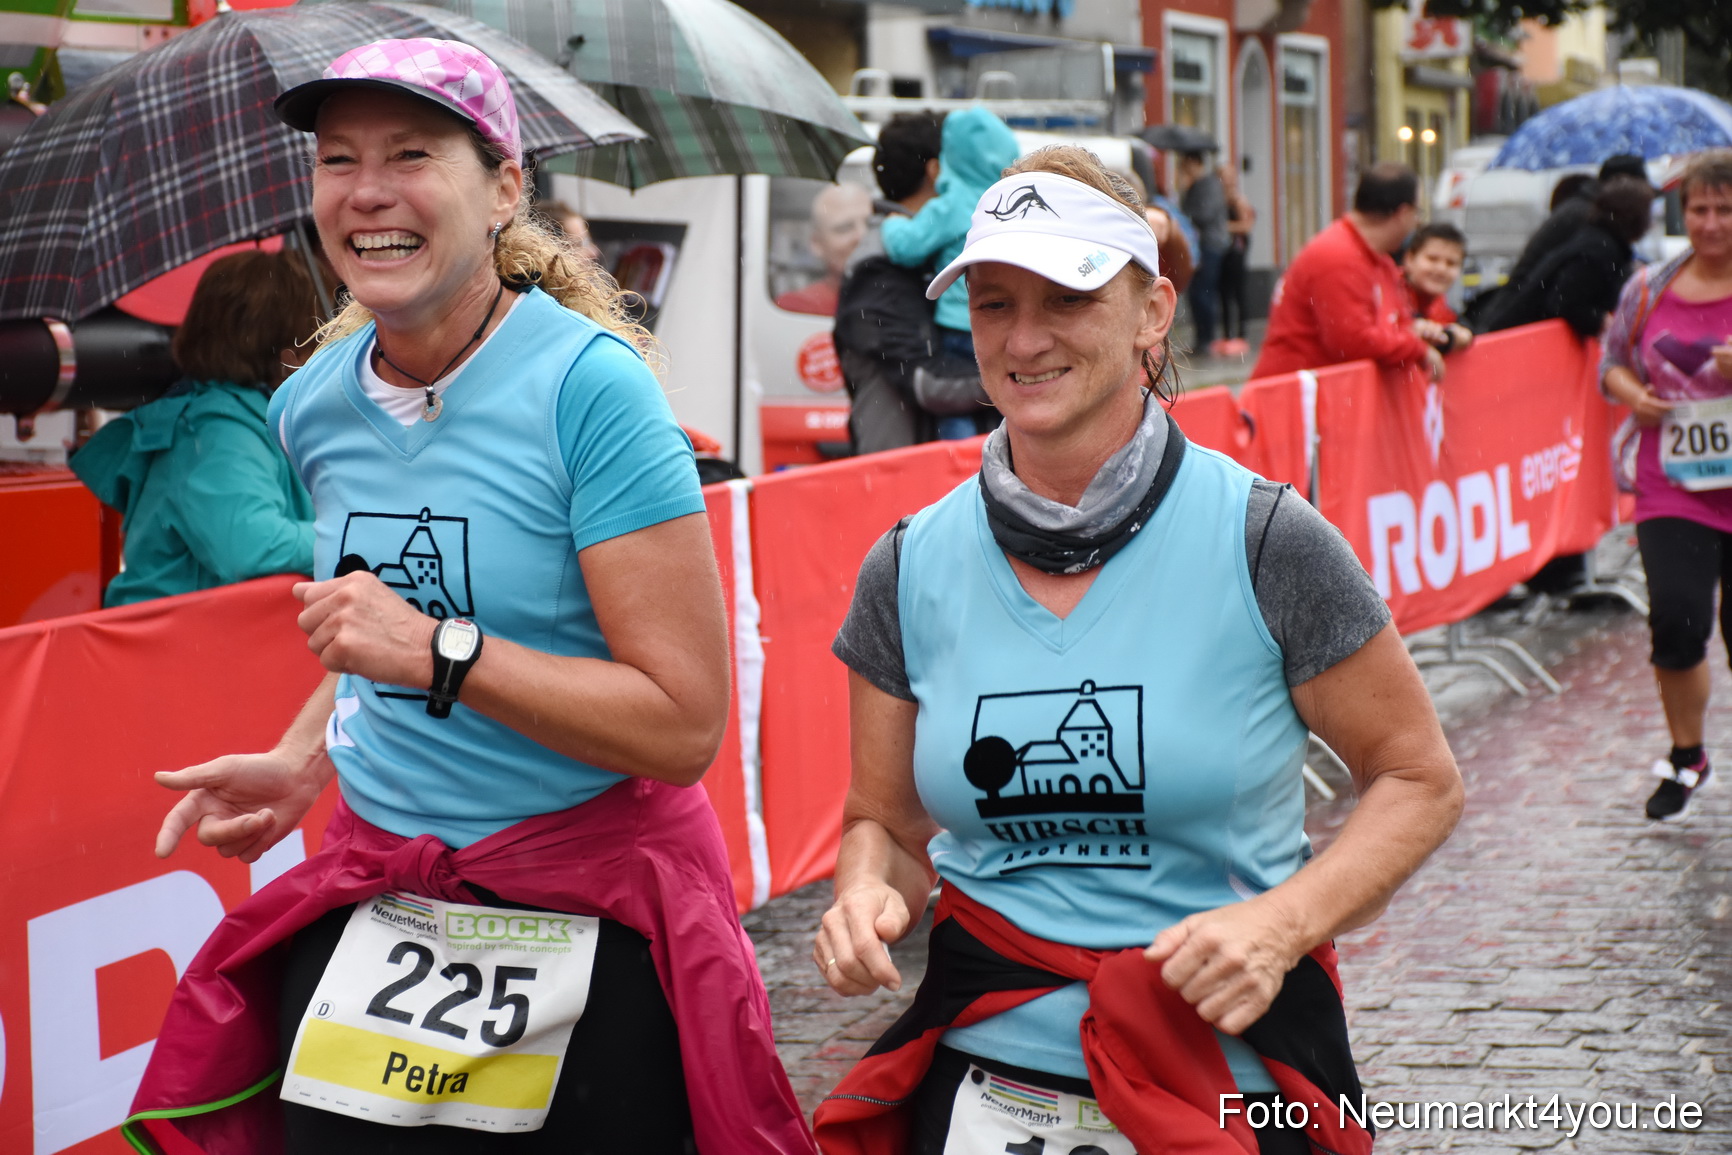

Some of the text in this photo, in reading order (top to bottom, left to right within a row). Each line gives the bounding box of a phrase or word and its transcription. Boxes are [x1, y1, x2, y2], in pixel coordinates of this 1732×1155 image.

[1078, 249, 1110, 277] sailfish
[1669, 421, 1730, 456] 206
[984, 818, 1149, 843] HIRSCH
[1003, 843, 1150, 864] APOTHEKE
[371, 904, 439, 935] NeuerMarkt
[446, 910, 572, 944] BOCK
[446, 940, 572, 956] nspired by smart concepts
[317, 1002, 330, 1017] D
[365, 940, 538, 1048] 225
[382, 1050, 469, 1096] Petra
[980, 1092, 1062, 1125] NeuerMarkt
